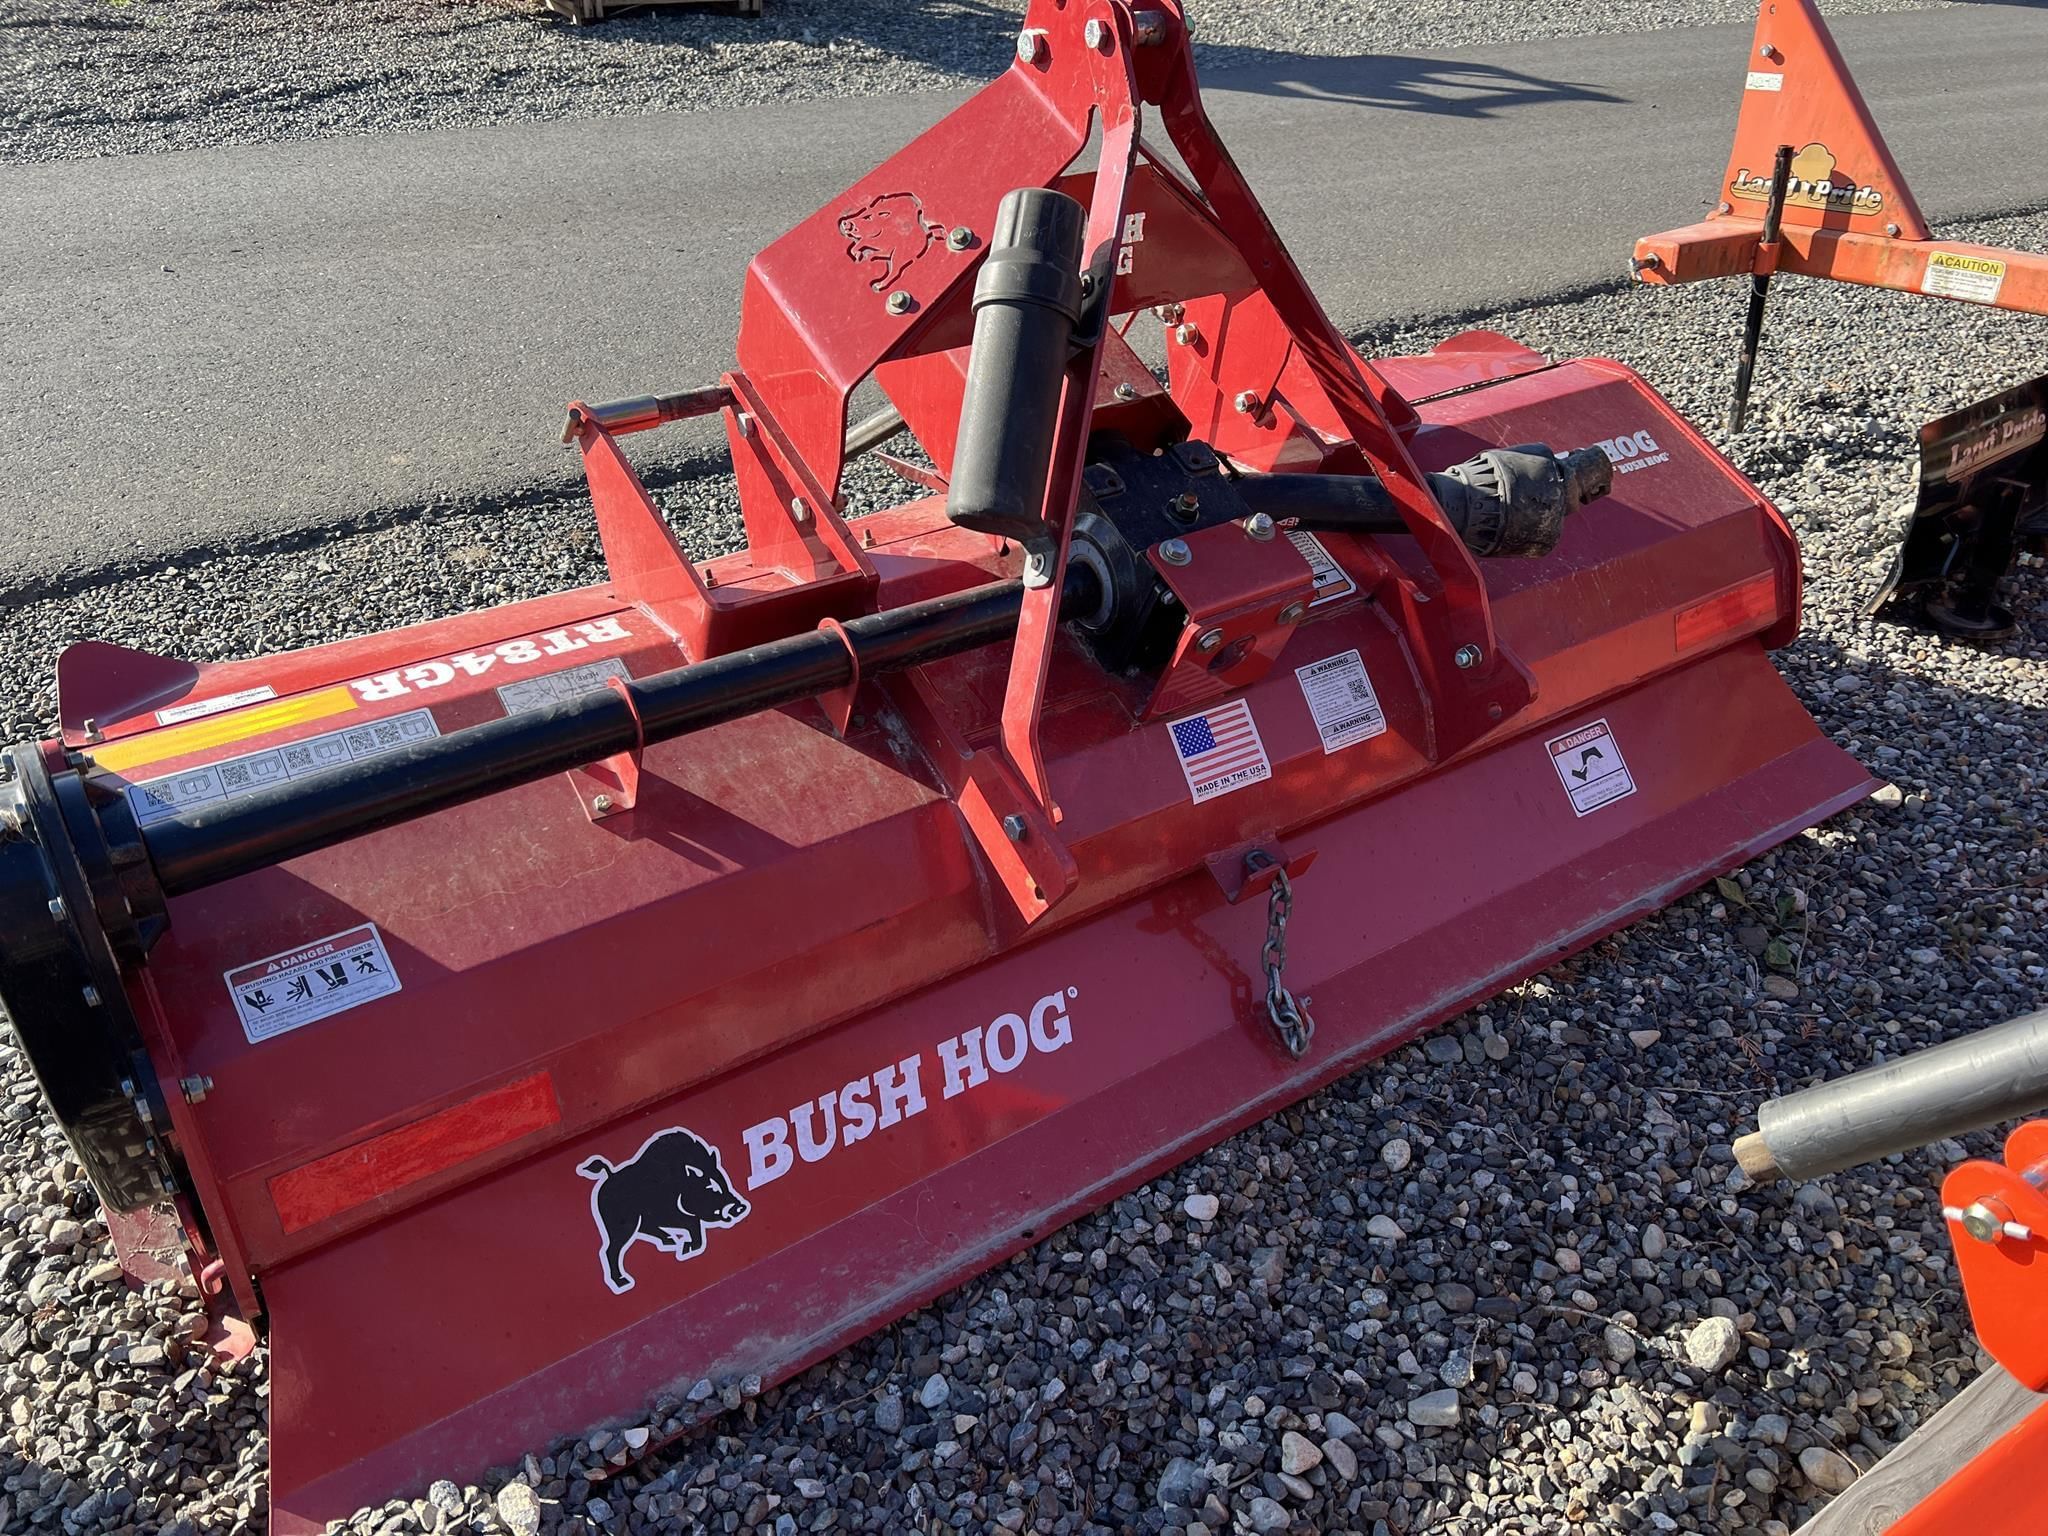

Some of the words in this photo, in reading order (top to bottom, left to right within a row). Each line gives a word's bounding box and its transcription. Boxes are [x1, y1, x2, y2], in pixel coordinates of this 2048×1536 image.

[1811, 180, 1883, 208] Pride
[1944, 256, 1999, 274] CAUTION
[1618, 459, 1648, 475] BUSH
[350, 617, 633, 702] RT84GR
[1316, 657, 1349, 673] WARNING
[1340, 713, 1371, 730] WARNING
[1566, 726, 1603, 747] DANGER
[1196, 780, 1220, 794] MADE
[1220, 776, 1231, 785] IN
[1231, 770, 1248, 781] THE
[1249, 764, 1267, 775] USA
[281, 943, 335, 968] DANGER
[240, 974, 278, 992] CRUSHING
[278, 965, 308, 979] HAZARD
[309, 959, 324, 969] AND
[325, 951, 346, 963] PINCH
[742, 1053, 927, 1191] BUSH
